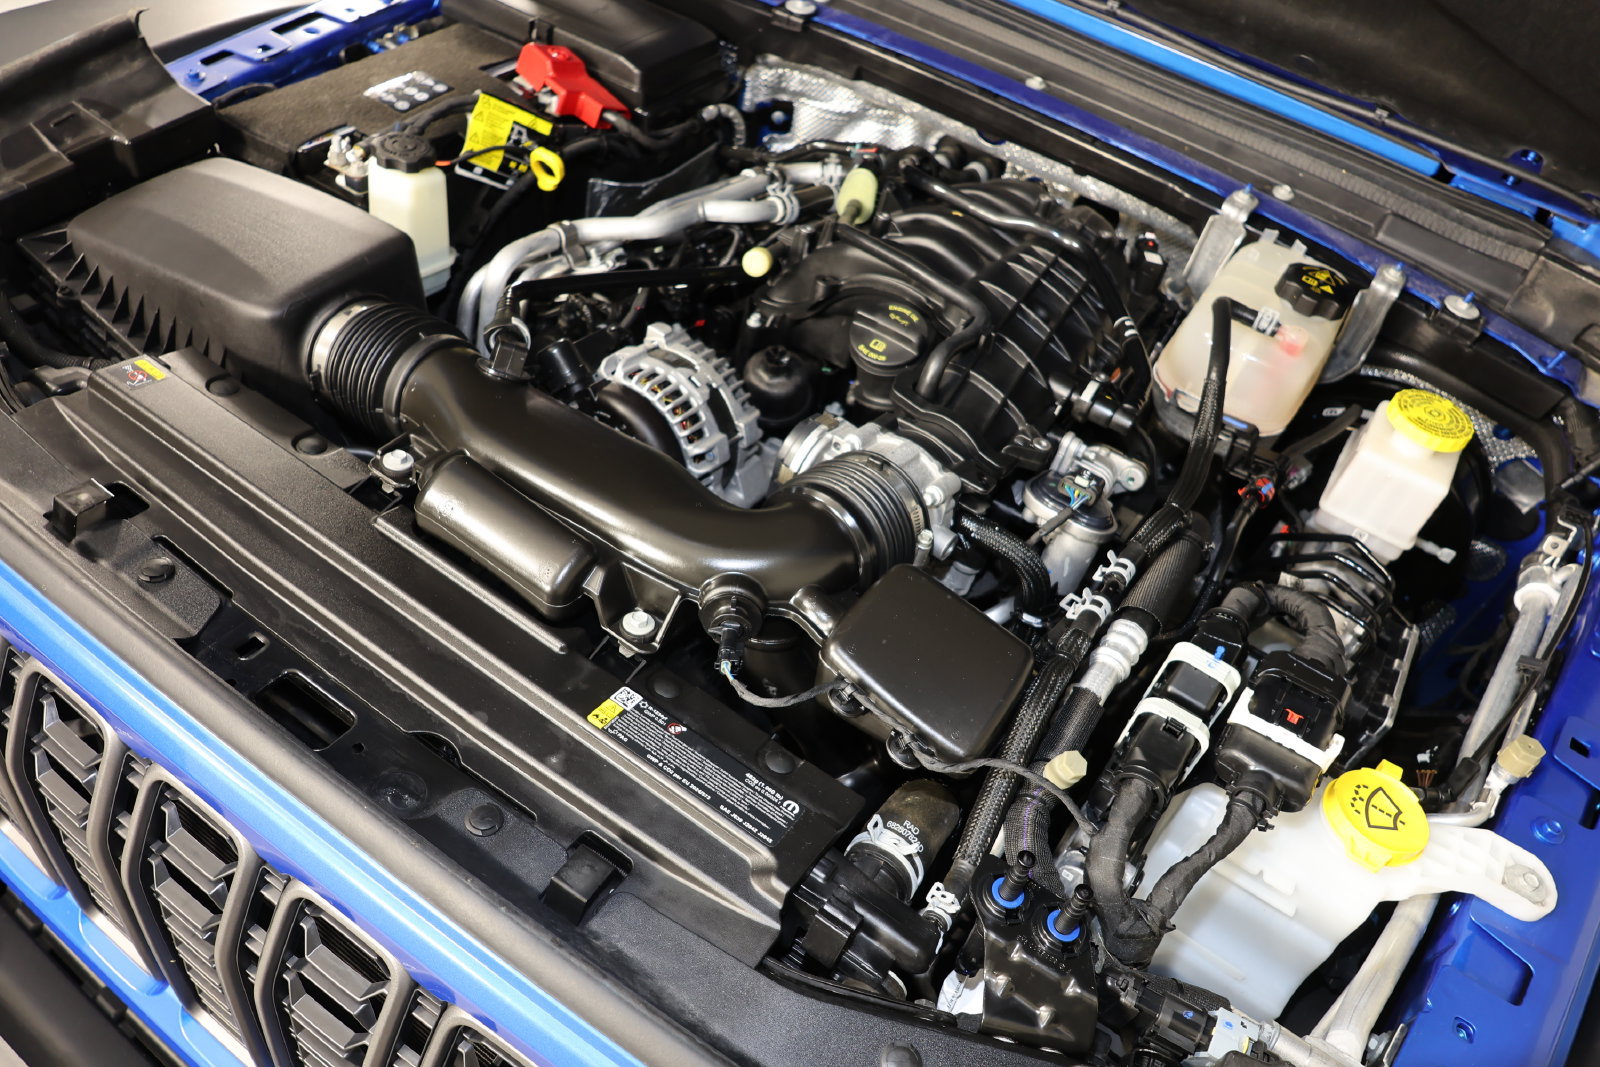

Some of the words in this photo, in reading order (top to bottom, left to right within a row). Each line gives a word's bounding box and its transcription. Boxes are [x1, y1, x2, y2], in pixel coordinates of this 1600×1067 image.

[617, 733, 628, 742] PAG
[646, 754, 659, 763] GWP
[662, 764, 674, 774] CO2
[672, 772, 682, 781] per
[682, 778, 690, 786] EU
[719, 804, 731, 814] SAE
[903, 820, 920, 835] RAD
